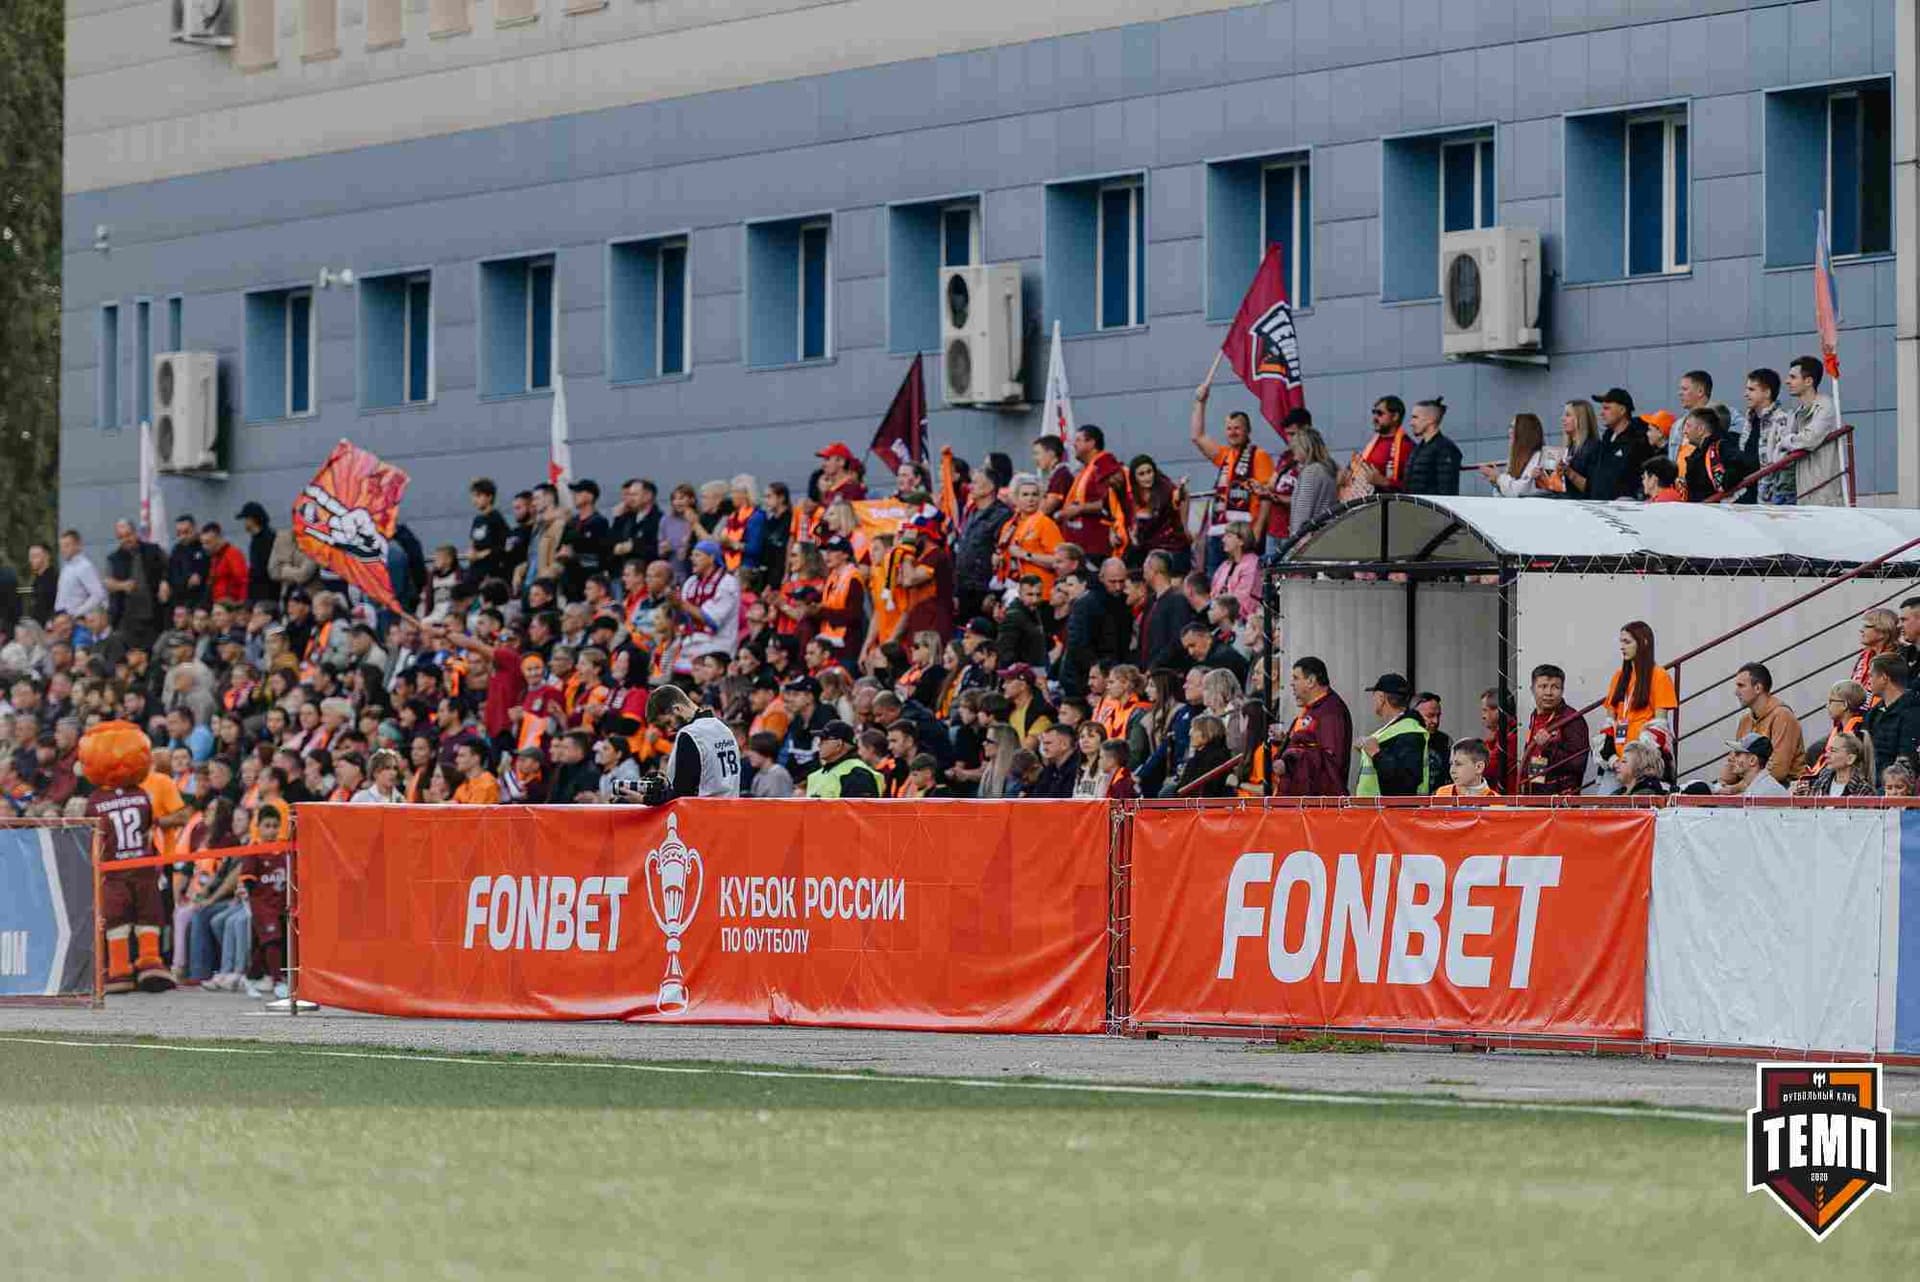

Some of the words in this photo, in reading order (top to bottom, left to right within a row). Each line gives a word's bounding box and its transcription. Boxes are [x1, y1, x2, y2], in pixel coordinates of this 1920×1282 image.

[108, 807, 142, 850] 12
[463, 876, 629, 951] FONBET
[720, 876, 796, 918] КУБОК
[805, 876, 906, 921] РОССИИ
[1217, 850, 1563, 990] FONBET
[721, 927, 740, 951] ПО
[743, 927, 810, 953] ФУТБОЛУ
